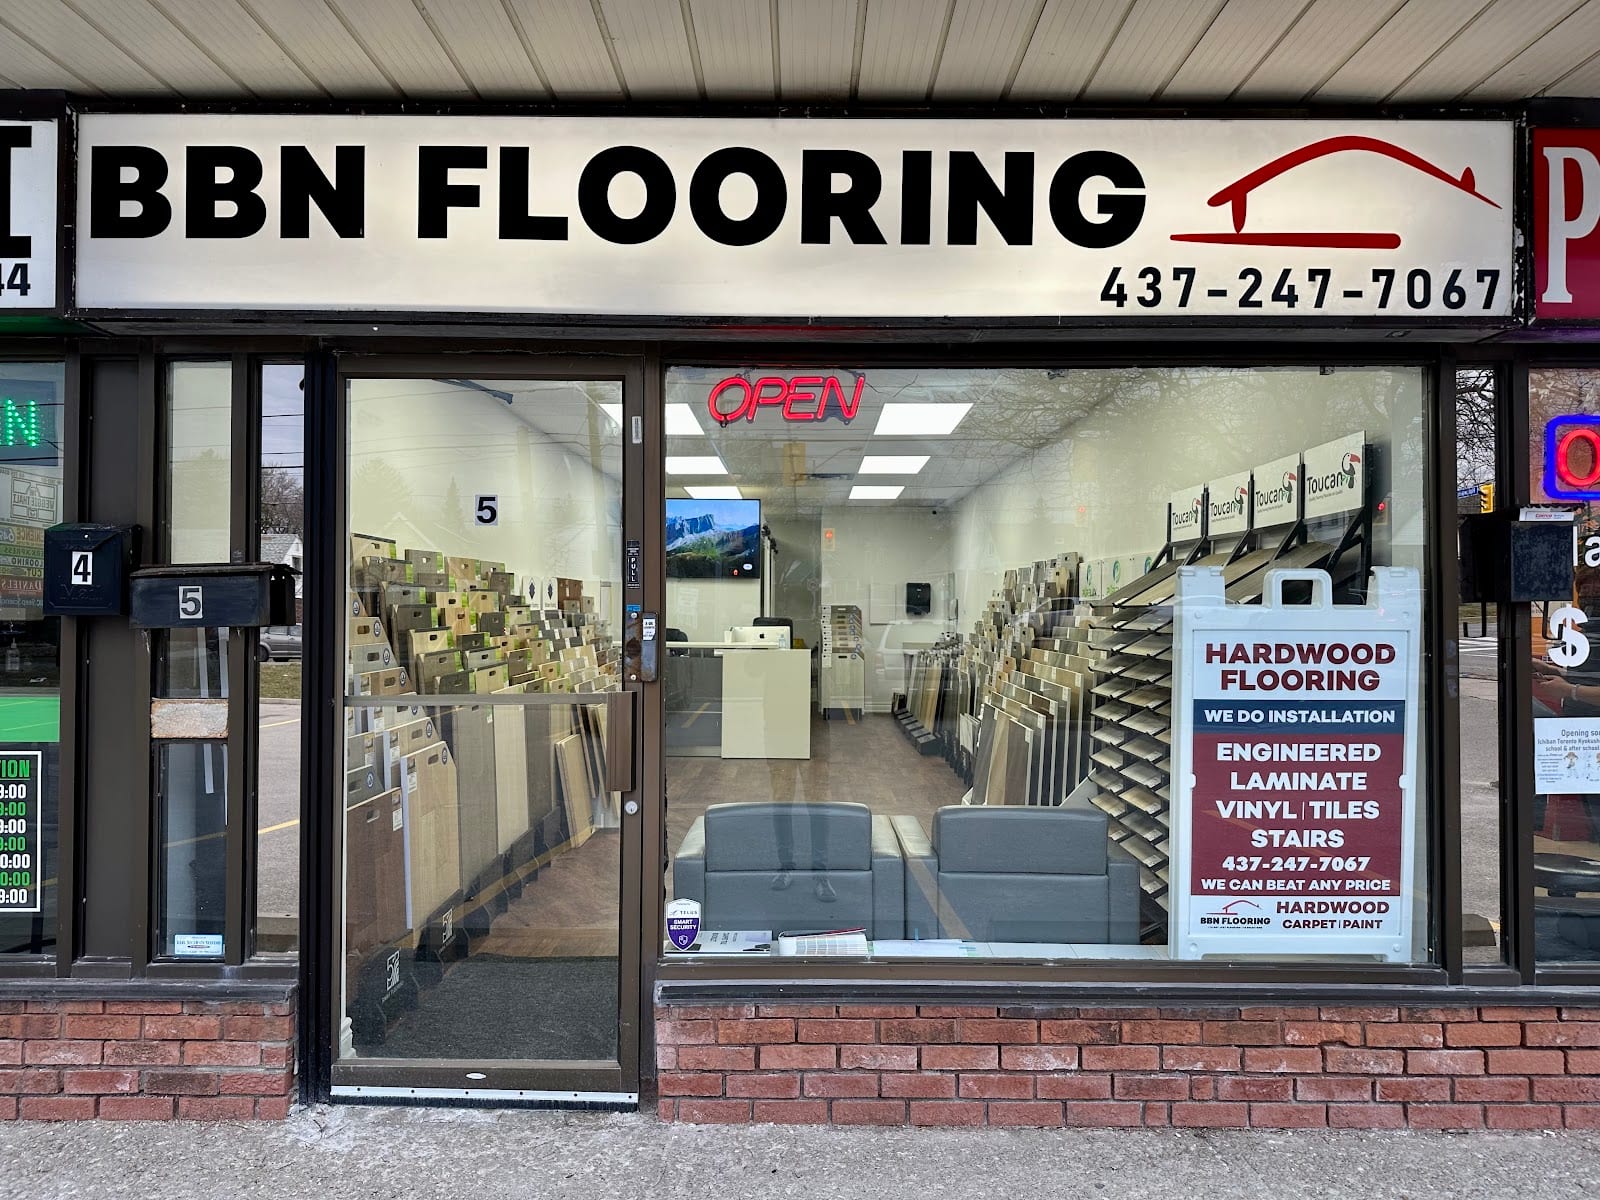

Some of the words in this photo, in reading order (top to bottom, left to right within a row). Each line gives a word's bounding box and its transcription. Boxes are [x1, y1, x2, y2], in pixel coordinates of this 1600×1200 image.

[90, 145, 365, 239] BBN
[417, 145, 1146, 249] FLOORING
[1542, 147, 1600, 303] P
[0, 263, 31, 296] 4
[1100, 265, 1500, 309] 437-247-7067
[708, 375, 866, 422] OPEN
[1306, 471, 1343, 495] Toucan
[1255, 487, 1284, 507] Toucan
[476, 496, 497, 524] 5
[1172, 510, 1193, 527] Toucan
[1210, 500, 1235, 517] Toucan
[73, 554, 91, 582] 4
[181, 587, 201, 616] 5
[1548, 603, 1590, 668] $
[1205, 643, 1396, 665] HARDWOOD
[1220, 669, 1381, 692] FLOORING
[1204, 709, 1233, 723] WE
[1237, 709, 1264, 723] DO
[1268, 710, 1395, 723] INSTALLATION
[1561, 729, 1589, 738] Opening
[1216, 743, 1382, 762] ENGINEERED
[0, 759, 30, 778] ION
[1230, 772, 1368, 791] LAMINATE
[1215, 800, 1298, 820] VINYL
[1308, 800, 1380, 820] TILES
[1251, 829, 1345, 848] STAIRS
[1222, 856, 1371, 872] 437-247-7067
[1201, 878, 1226, 891] WE
[1229, 879, 1263, 891] CAN
[1266, 879, 1306, 891] BEAT
[1308, 879, 1342, 891] ANY
[1345, 879, 1391, 891] PRICE
[1276, 901, 1390, 914] HARDWOOD
[1200, 917, 1220, 925] BBN
[1221, 917, 1271, 925] FLOORING
[1282, 919, 1337, 929] CARPET
[1342, 919, 1383, 929] PAINT
